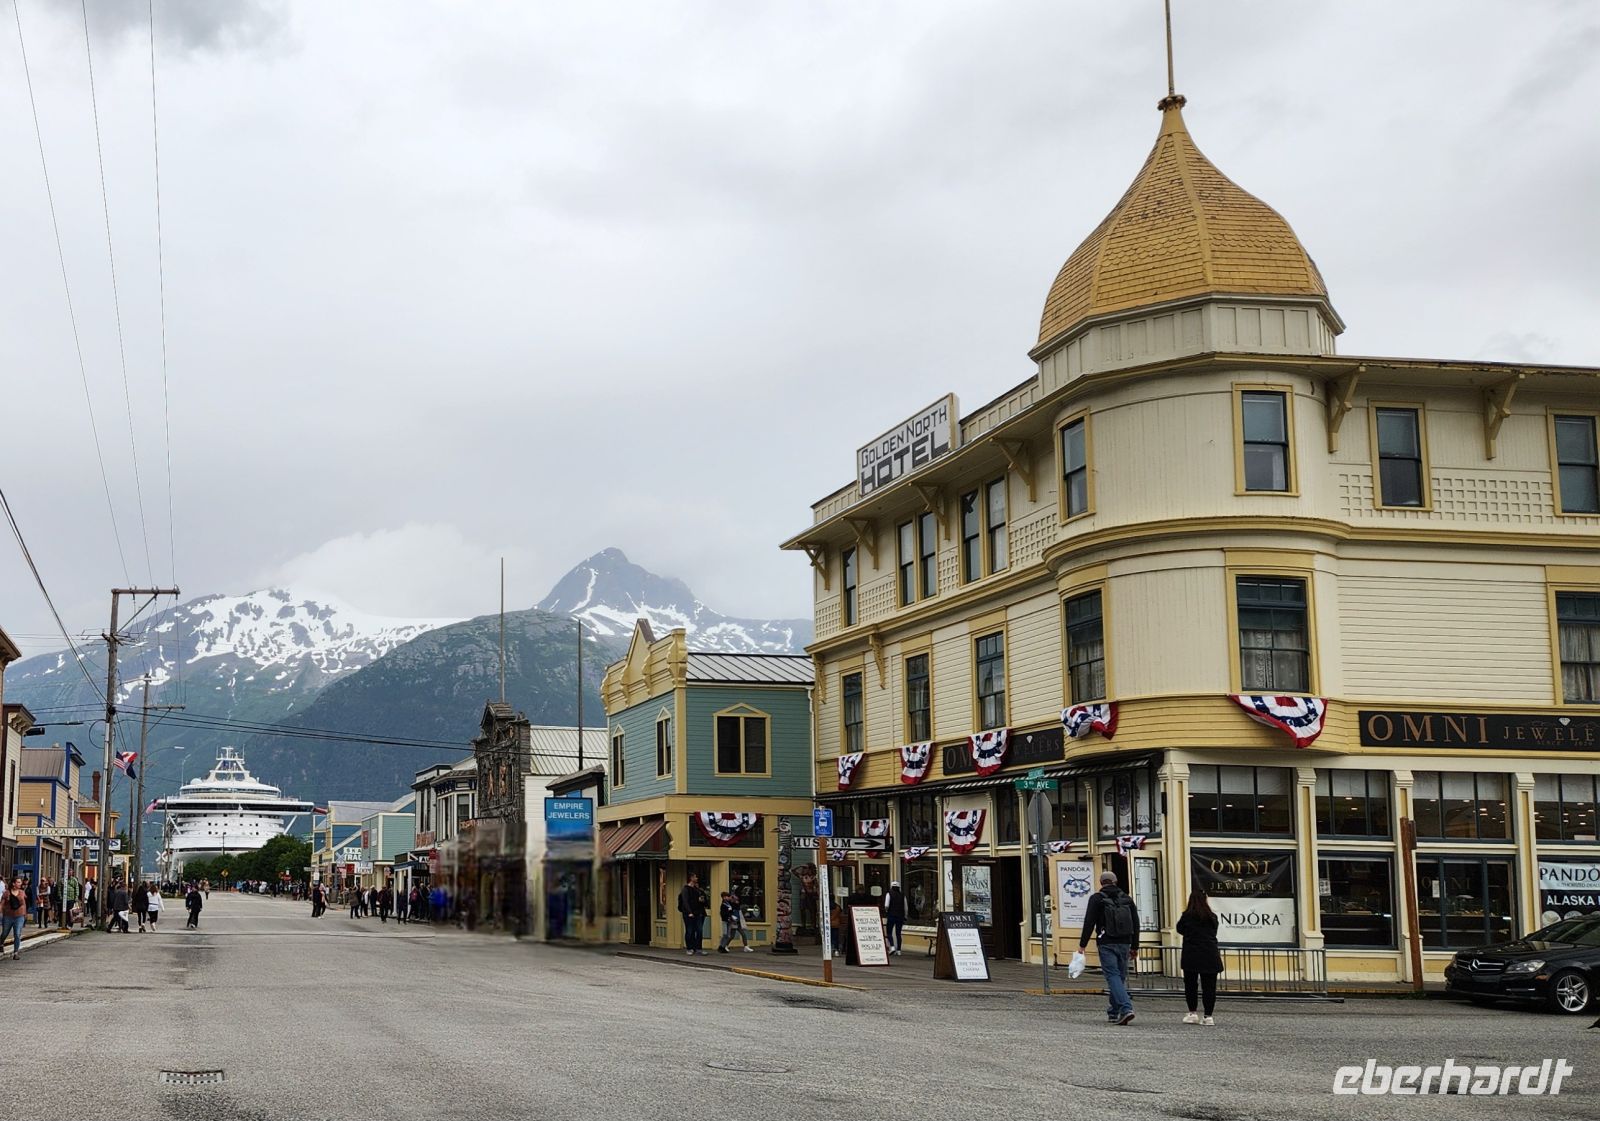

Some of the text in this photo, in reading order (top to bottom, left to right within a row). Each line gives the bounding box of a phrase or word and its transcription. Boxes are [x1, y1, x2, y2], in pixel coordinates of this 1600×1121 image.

[862, 405, 947, 468] GOLDEN NORTH
[861, 431, 949, 496] HOTEL
[1367, 714, 1596, 744] OMNI JEWELE
[946, 747, 973, 769] OM
[1036, 781, 1050, 789] AVE
[553, 802, 584, 810] EMPIRE
[547, 811, 590, 820] JEWELERS
[46, 828, 71, 836] LOCAL
[72, 828, 87, 836] ART
[74, 839, 119, 847] RICHRS
[1210, 859, 1272, 875] OMNI
[1210, 882, 1273, 891] JEWELERS
[1421, 876, 1471, 890] ONI
[1546, 895, 1596, 906] ALASKA
[1220, 910, 1281, 926] NDORA
